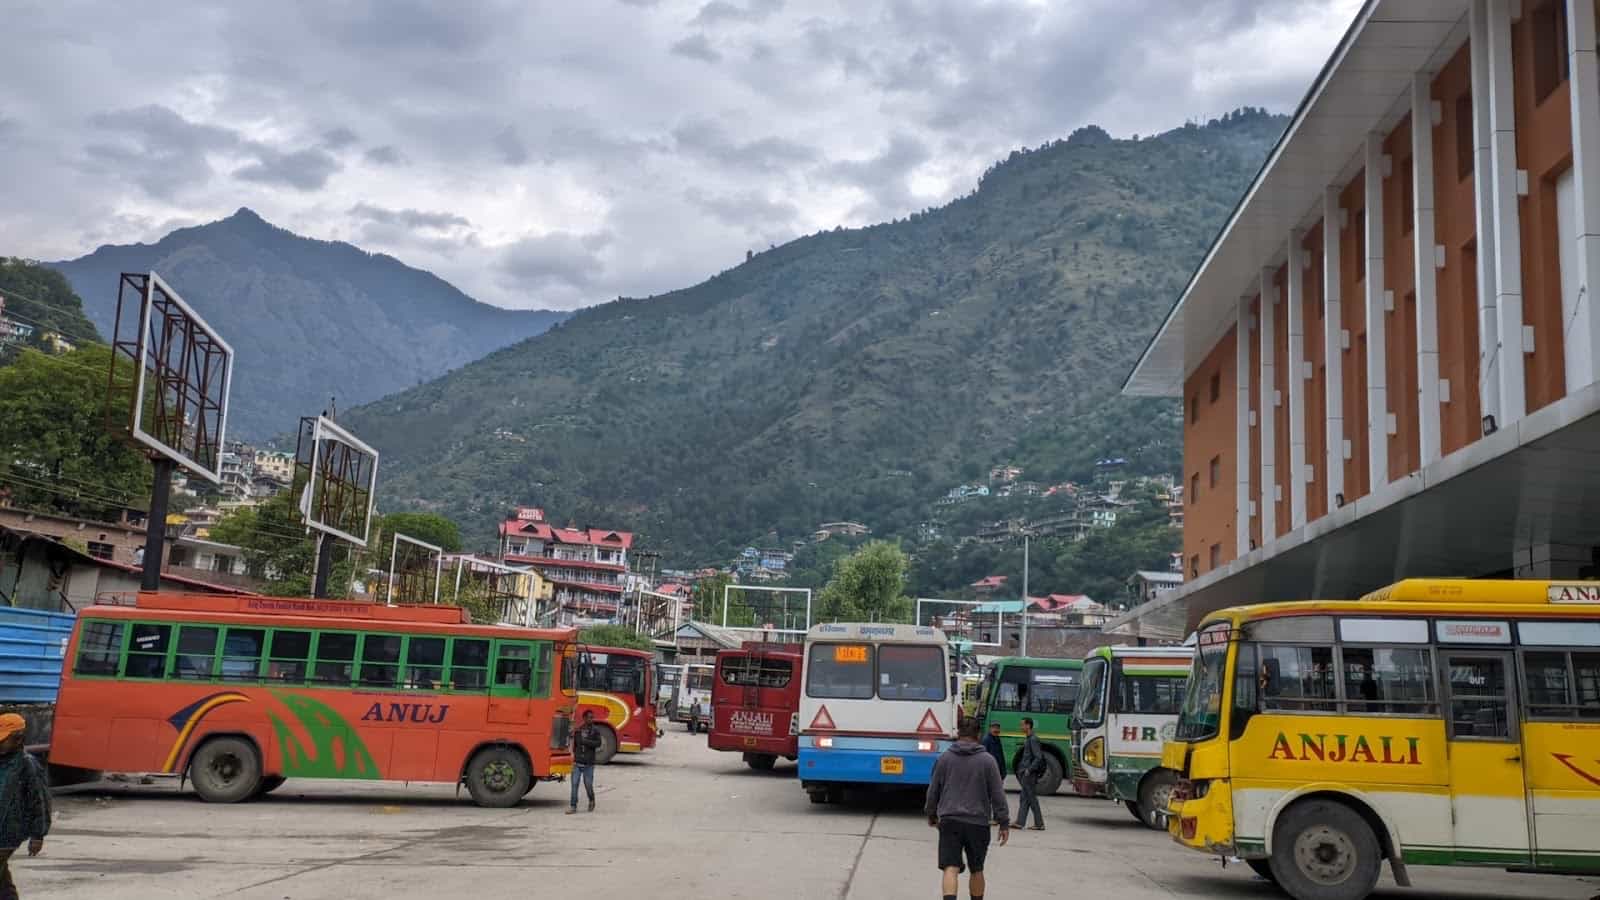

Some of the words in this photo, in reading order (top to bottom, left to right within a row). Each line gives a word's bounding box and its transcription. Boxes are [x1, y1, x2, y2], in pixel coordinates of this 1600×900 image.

[1469, 676, 1486, 685] OUT
[361, 702, 451, 724] ANUJ
[730, 711, 775, 724] ANJALI
[1269, 730, 1424, 765] ANJALI
